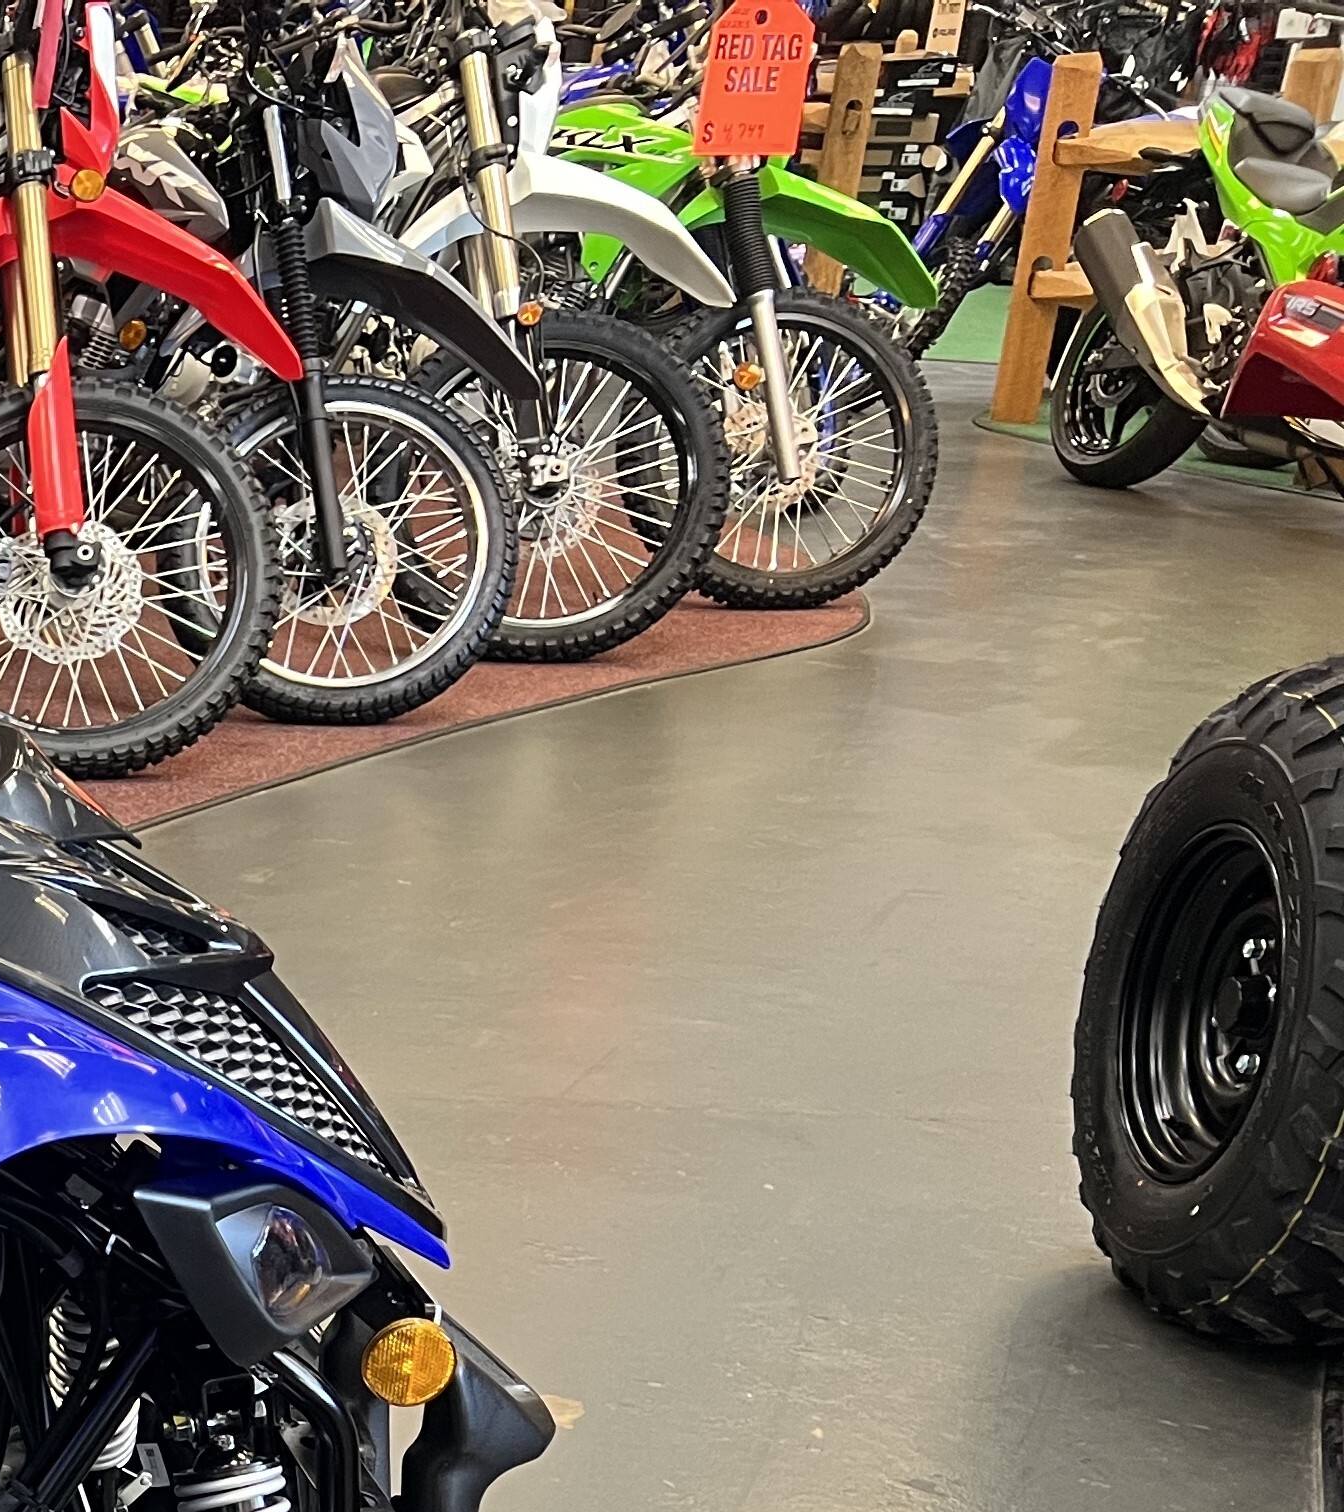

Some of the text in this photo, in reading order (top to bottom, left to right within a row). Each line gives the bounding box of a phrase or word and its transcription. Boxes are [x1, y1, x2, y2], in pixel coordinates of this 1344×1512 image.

[714, 33, 803, 61] RED TAG
[724, 66, 780, 92] SALE
